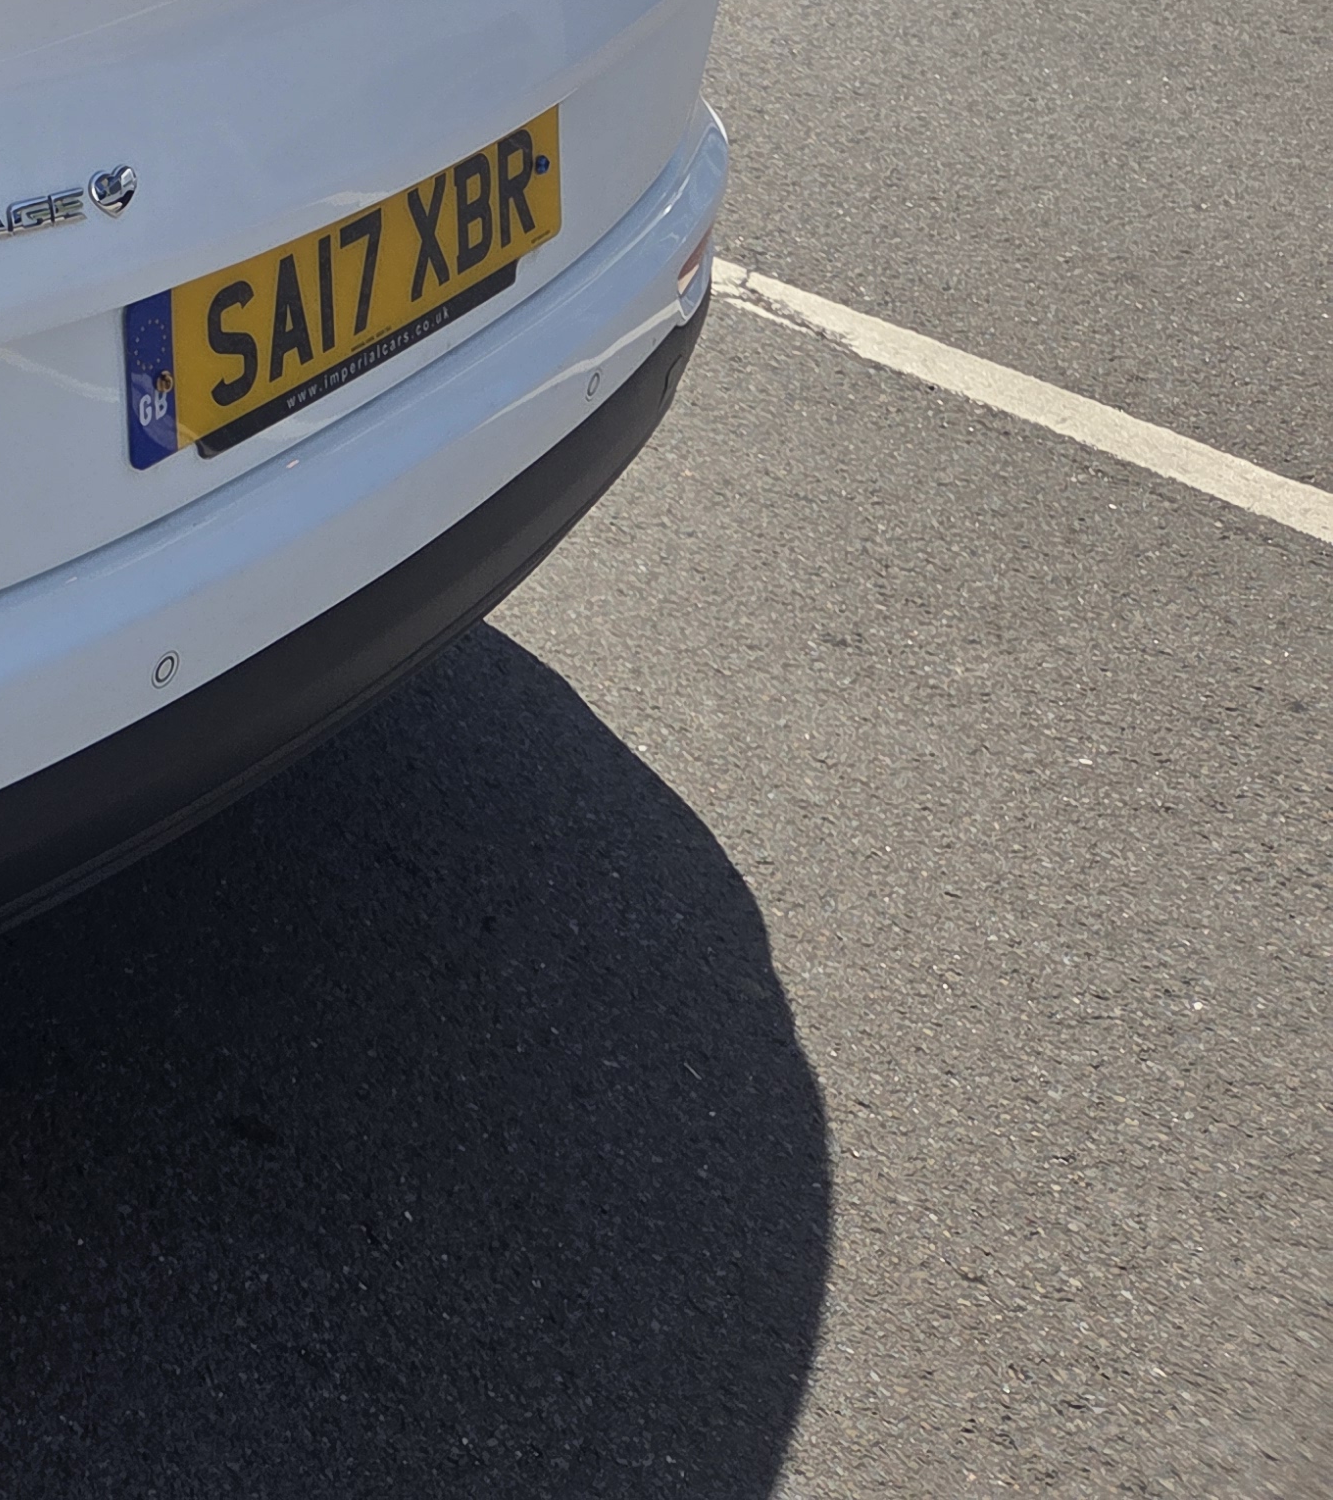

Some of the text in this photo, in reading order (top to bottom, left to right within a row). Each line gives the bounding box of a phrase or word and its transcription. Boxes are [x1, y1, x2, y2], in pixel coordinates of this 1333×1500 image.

[205, 129, 536, 408] SA17 XBR
[139, 389, 169, 427] GB
[286, 305, 450, 410] www.imperialcars.co.uk
